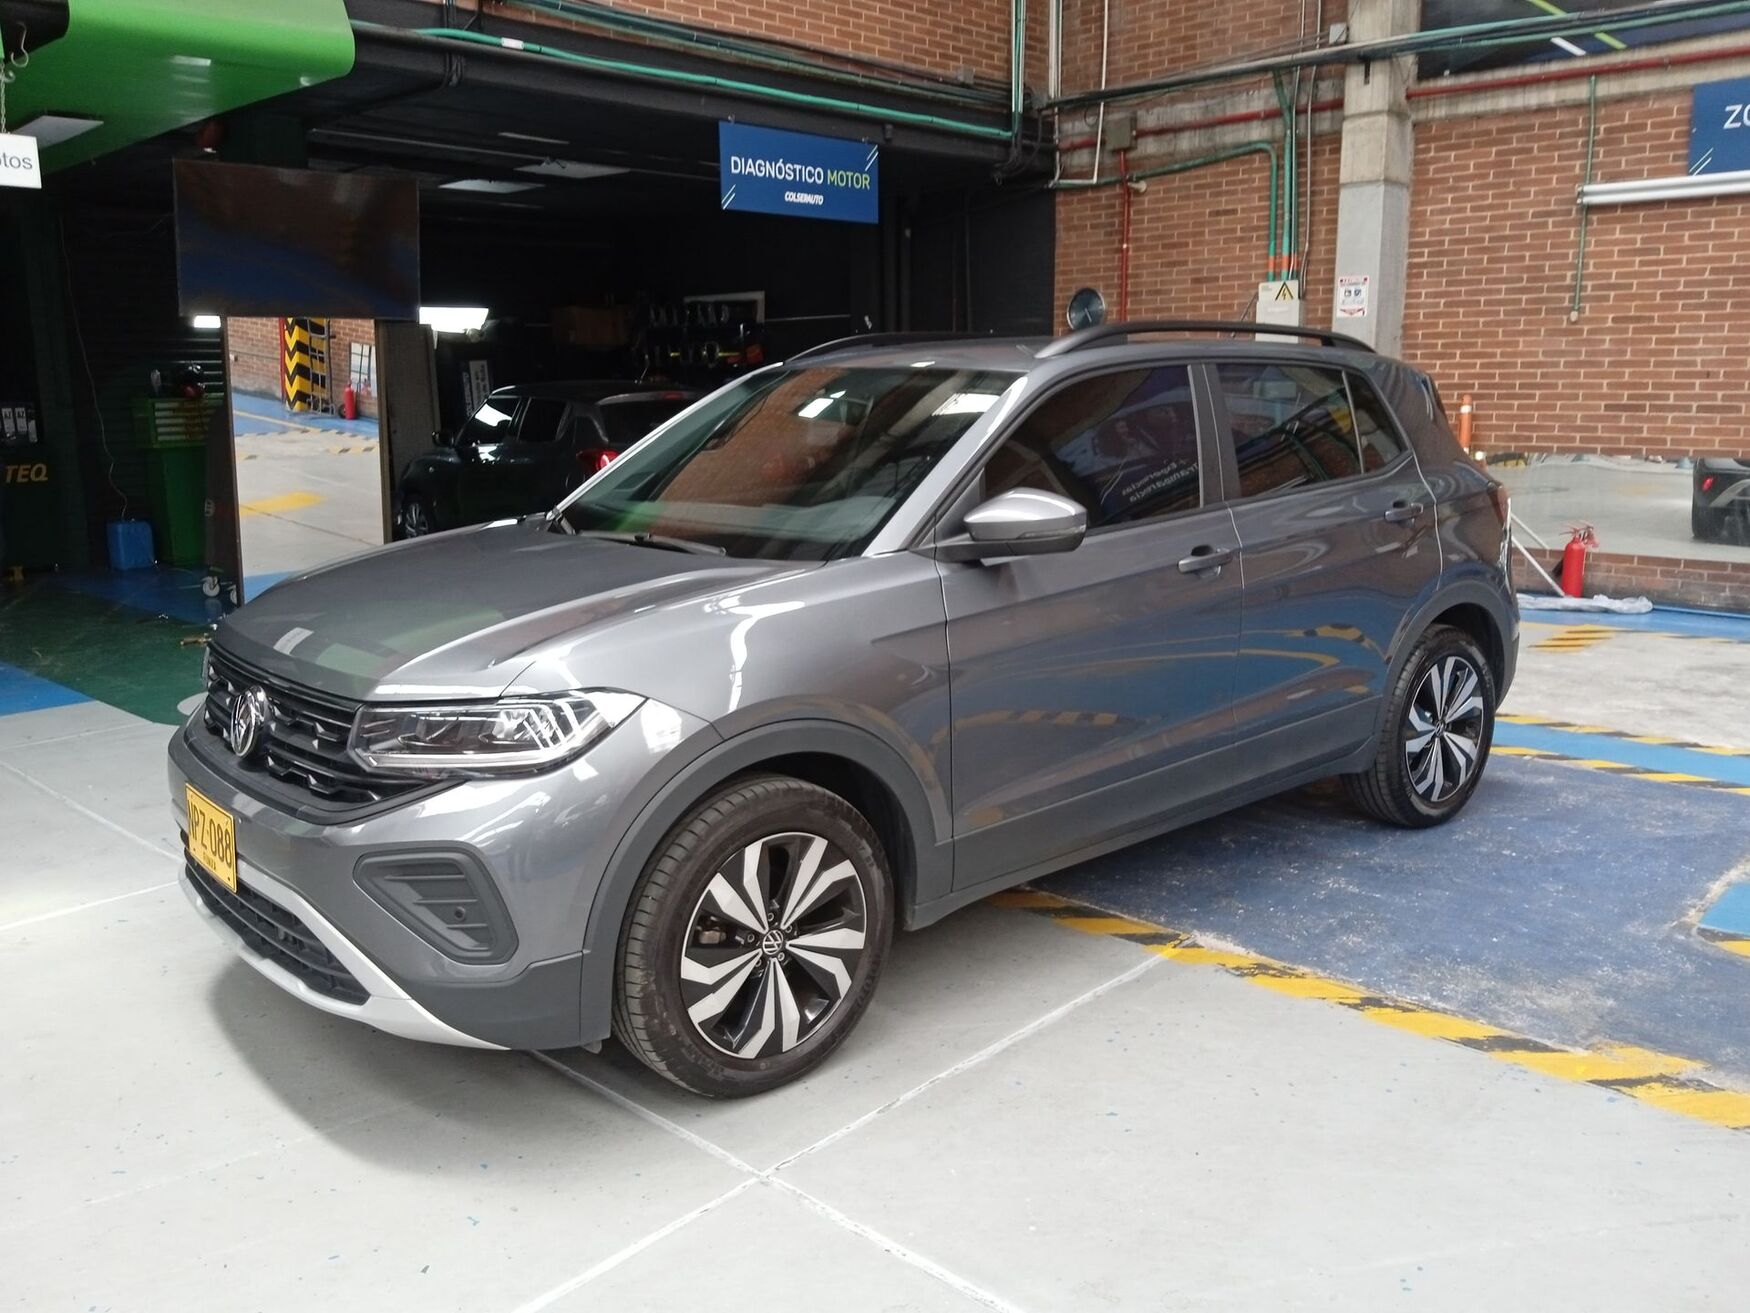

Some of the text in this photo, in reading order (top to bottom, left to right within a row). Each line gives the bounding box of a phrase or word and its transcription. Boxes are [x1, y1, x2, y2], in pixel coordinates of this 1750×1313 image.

[0, 152, 33, 170] tos
[730, 156, 870, 190] DIAGNÓSTICO MOTOR
[4, 463, 49, 484] TEQ
